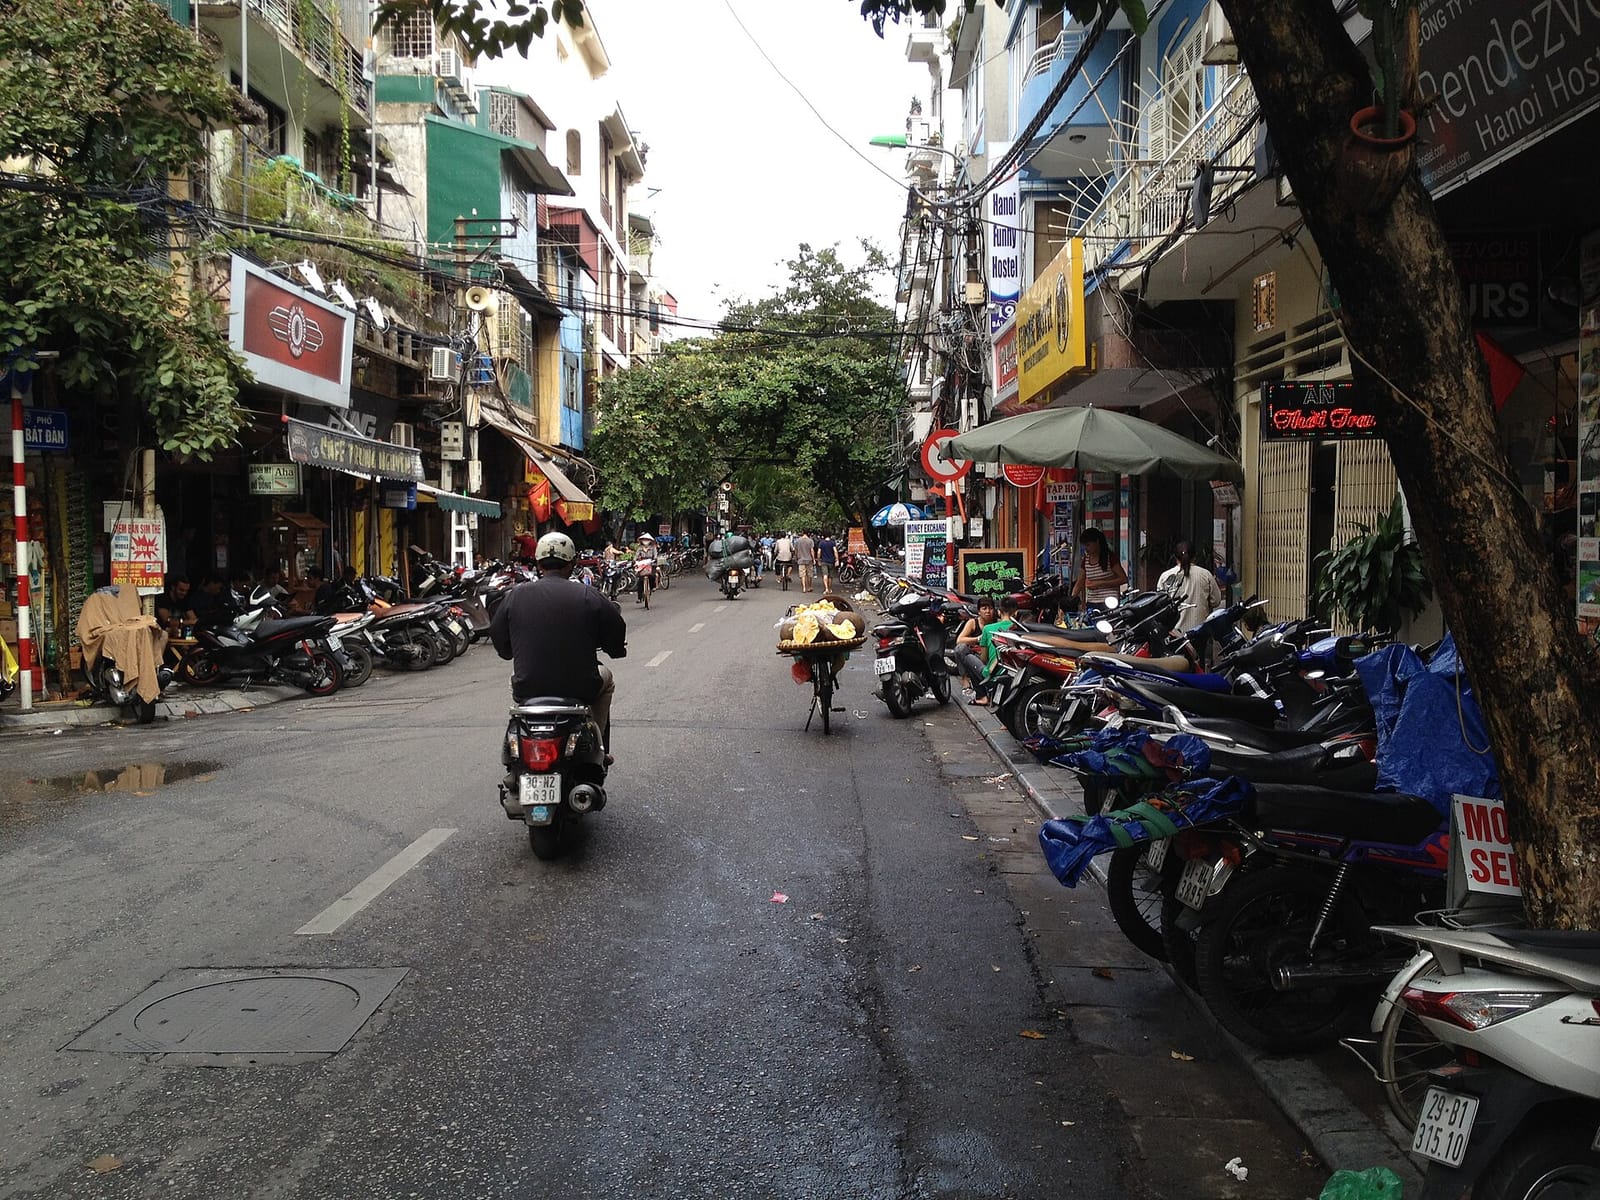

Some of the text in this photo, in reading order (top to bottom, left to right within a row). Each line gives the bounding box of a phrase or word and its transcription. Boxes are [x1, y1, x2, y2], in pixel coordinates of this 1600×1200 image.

[1418, 0, 1600, 133] Rendezv
[1475, 83, 1543, 151] Hanoi
[992, 193, 1016, 216] Hanoi
[993, 224, 1017, 249] Funny
[992, 256, 1018, 278] Hostel
[1303, 388, 1335, 405] AN
[25, 425, 43, 443] BÁT
[275, 467, 294, 477] Aha
[907, 523, 947, 533] MONEY EXCHANG
[526, 789, 555, 801] 5630
[1415, 1122, 1464, 1161] 315.10
